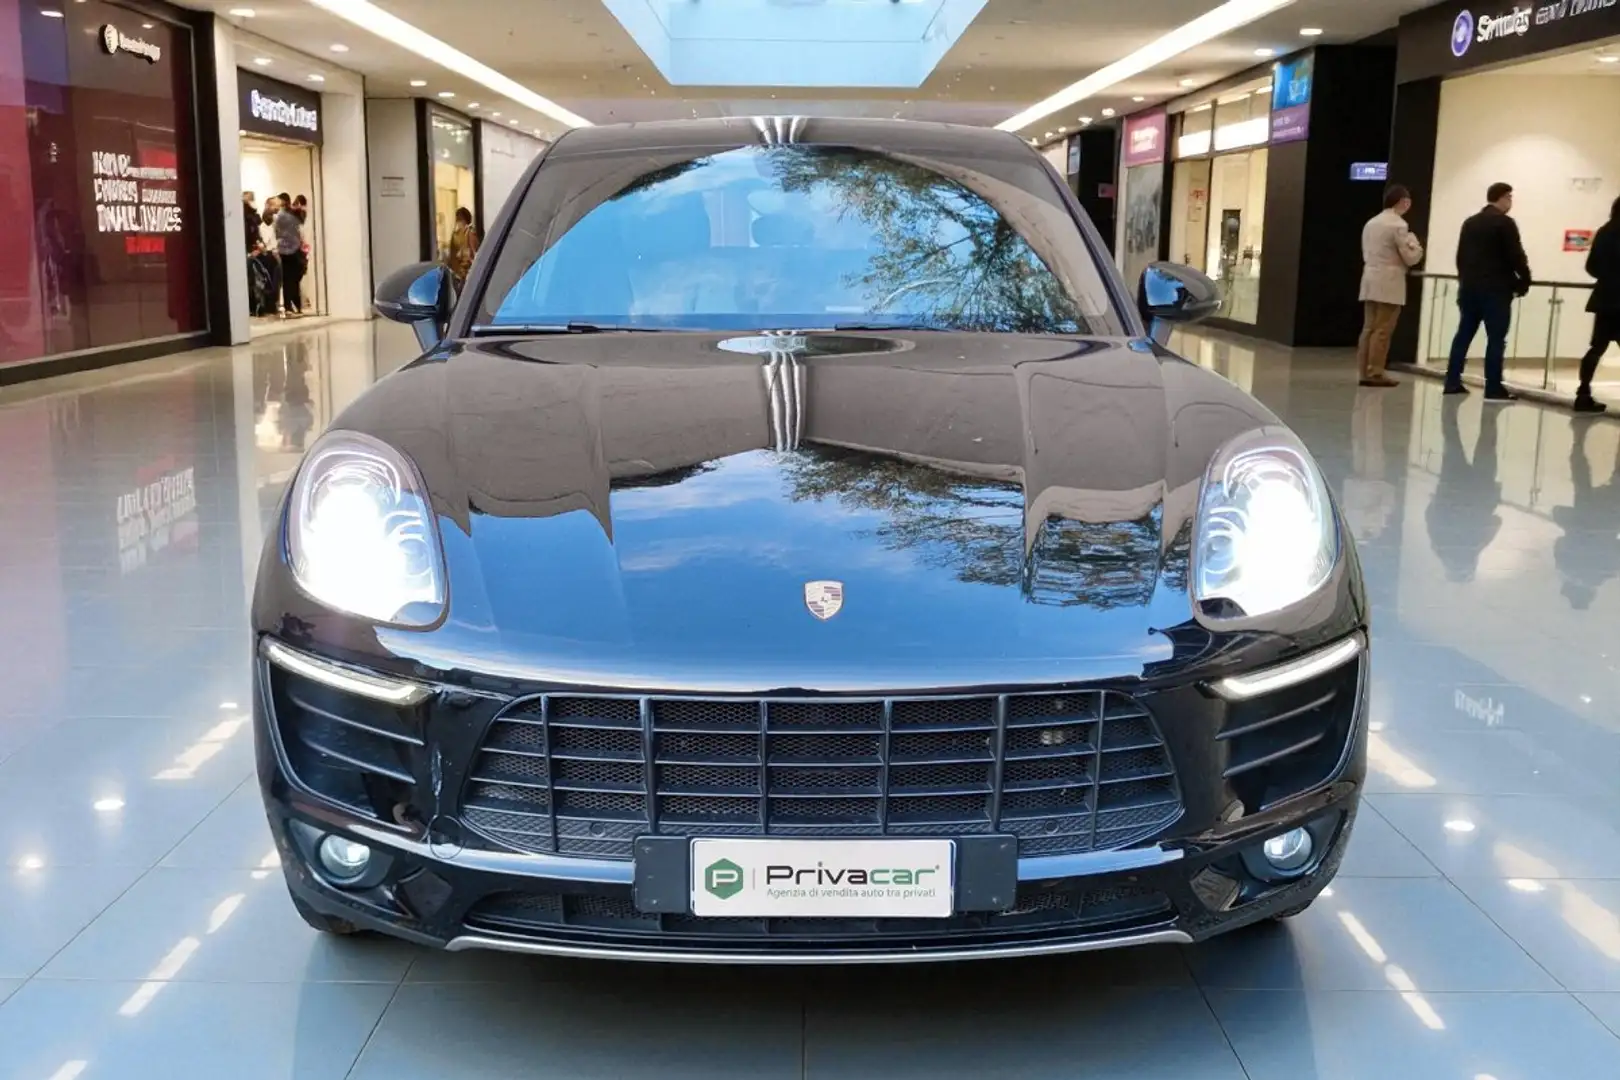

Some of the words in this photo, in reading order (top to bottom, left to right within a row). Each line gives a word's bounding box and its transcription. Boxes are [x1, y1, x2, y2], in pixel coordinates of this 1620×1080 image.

[766, 861, 936, 885] Privacar
[767, 887, 807, 898] Agenzia
[809, 887, 818, 898] di
[821, 887, 858, 898] vendita
[861, 888, 884, 898] auto
[887, 888, 901, 898] tra
[903, 887, 936, 899] privati
